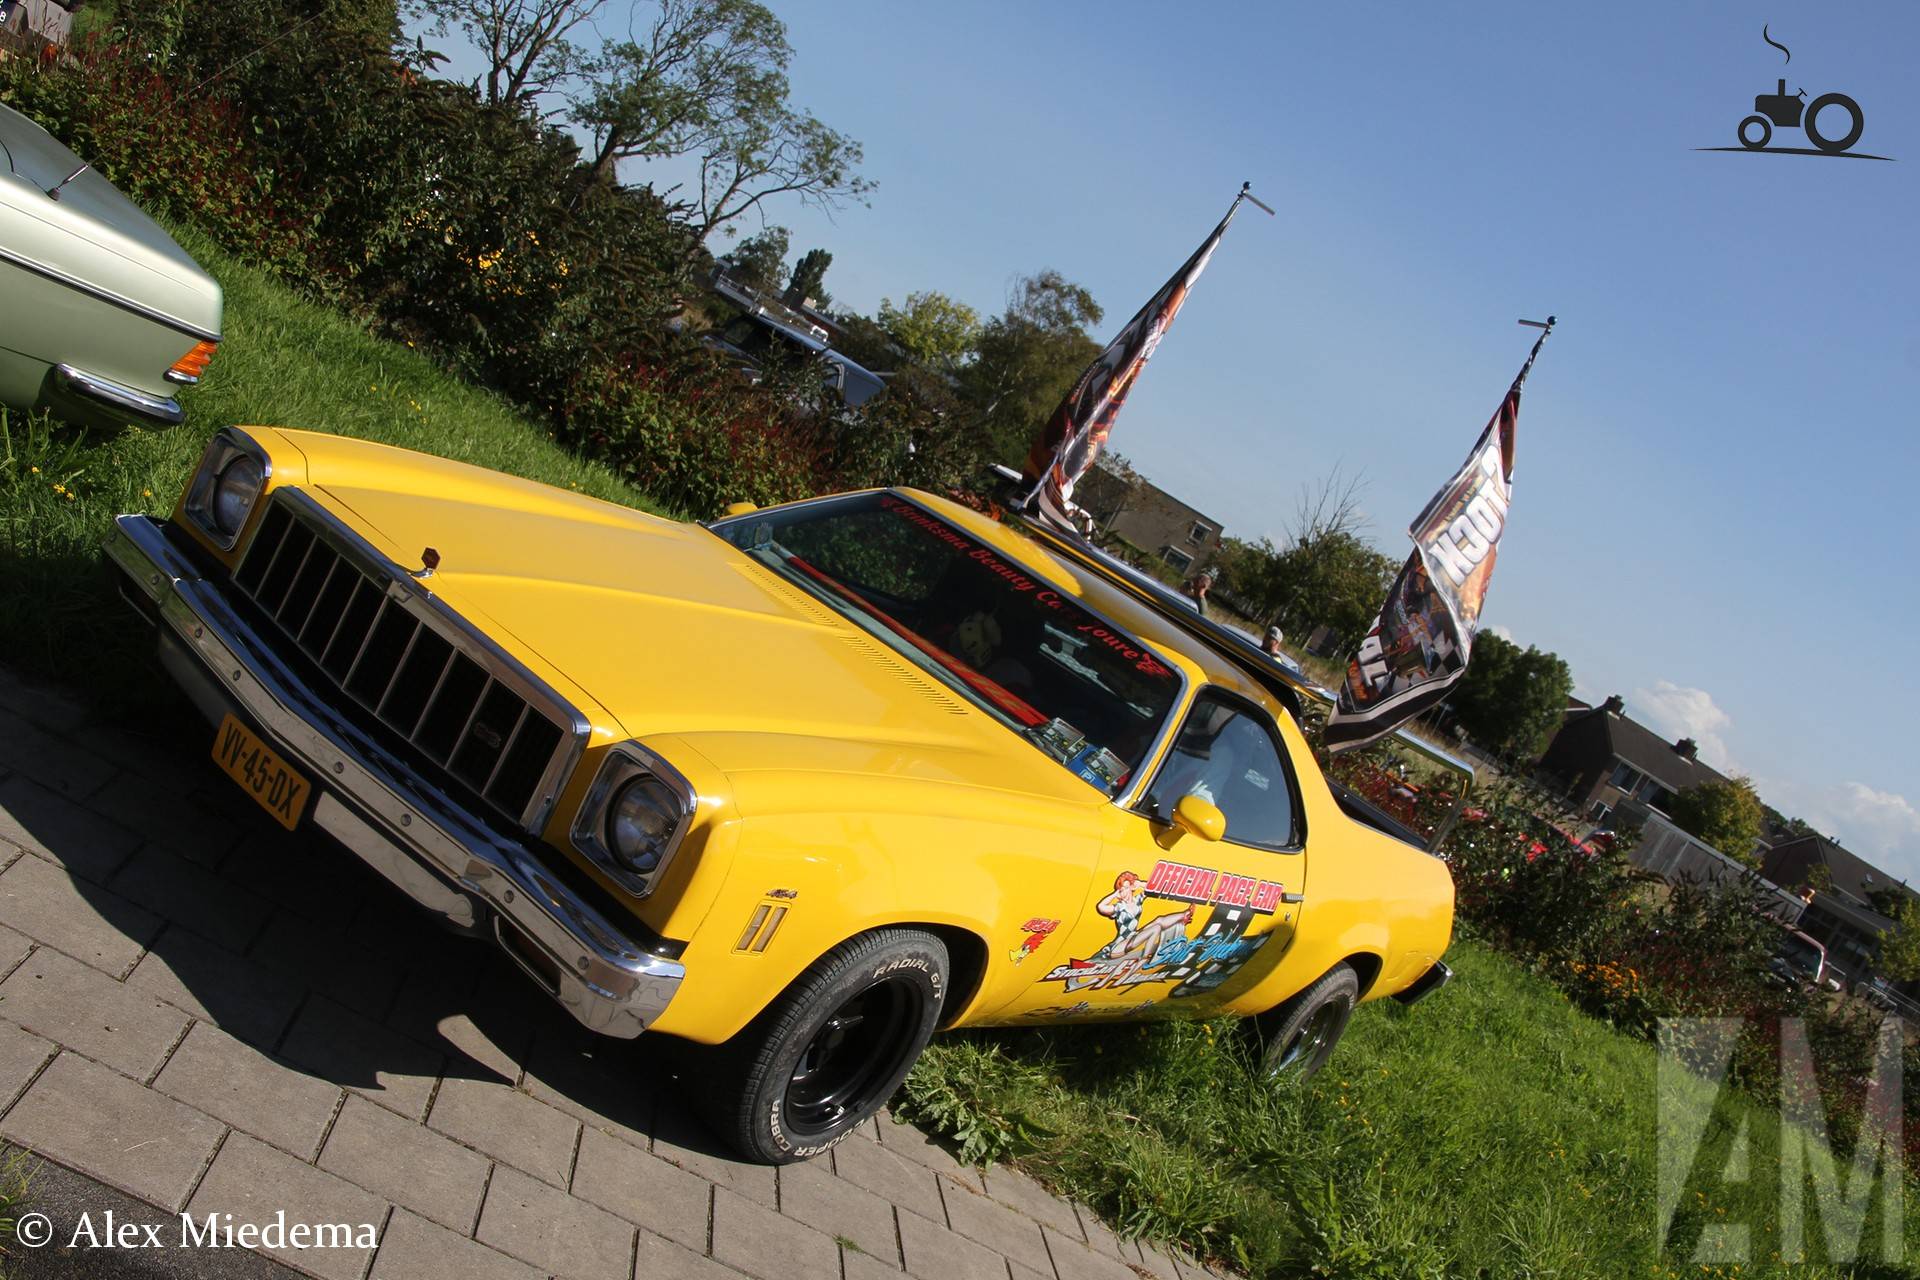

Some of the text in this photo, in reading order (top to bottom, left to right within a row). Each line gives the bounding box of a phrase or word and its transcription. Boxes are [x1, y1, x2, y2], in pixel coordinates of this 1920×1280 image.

[969, 550, 1036, 591] Beauty
[222, 722, 301, 819] VV-45-DX
[1145, 861, 1284, 913] OFFICIAL PACE CAR
[873, 958, 929, 979] RADIAL
[770, 1099, 865, 1157] COOPER COBRA
